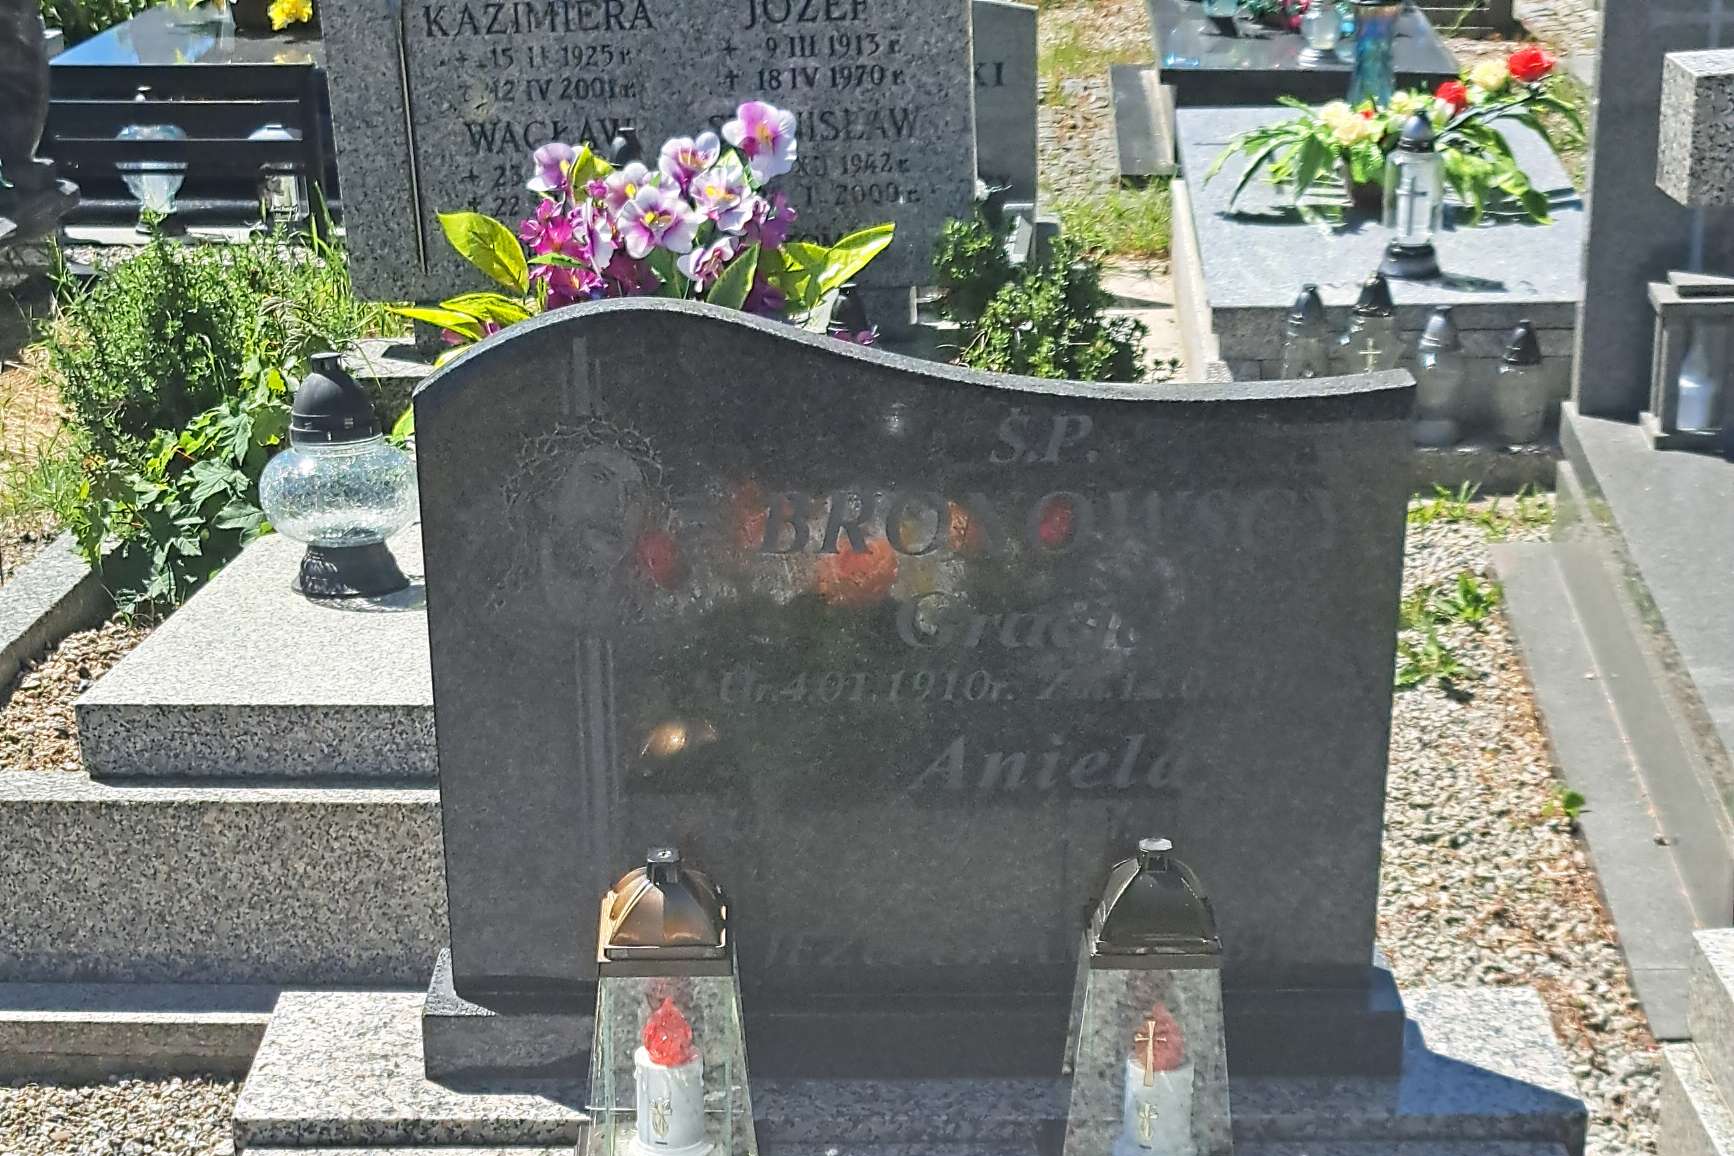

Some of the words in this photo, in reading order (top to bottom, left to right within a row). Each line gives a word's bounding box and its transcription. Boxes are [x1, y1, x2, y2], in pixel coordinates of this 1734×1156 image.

[423, 0, 656, 37] KAZIMIERA
[561, 44, 615, 67] 1925
[788, 35, 816, 57] III
[828, 33, 880, 57] 1913
[758, 68, 782, 90] 18
[790, 67, 820, 88] IV
[830, 64, 885, 90] 1970
[526, 79, 553, 101] IV
